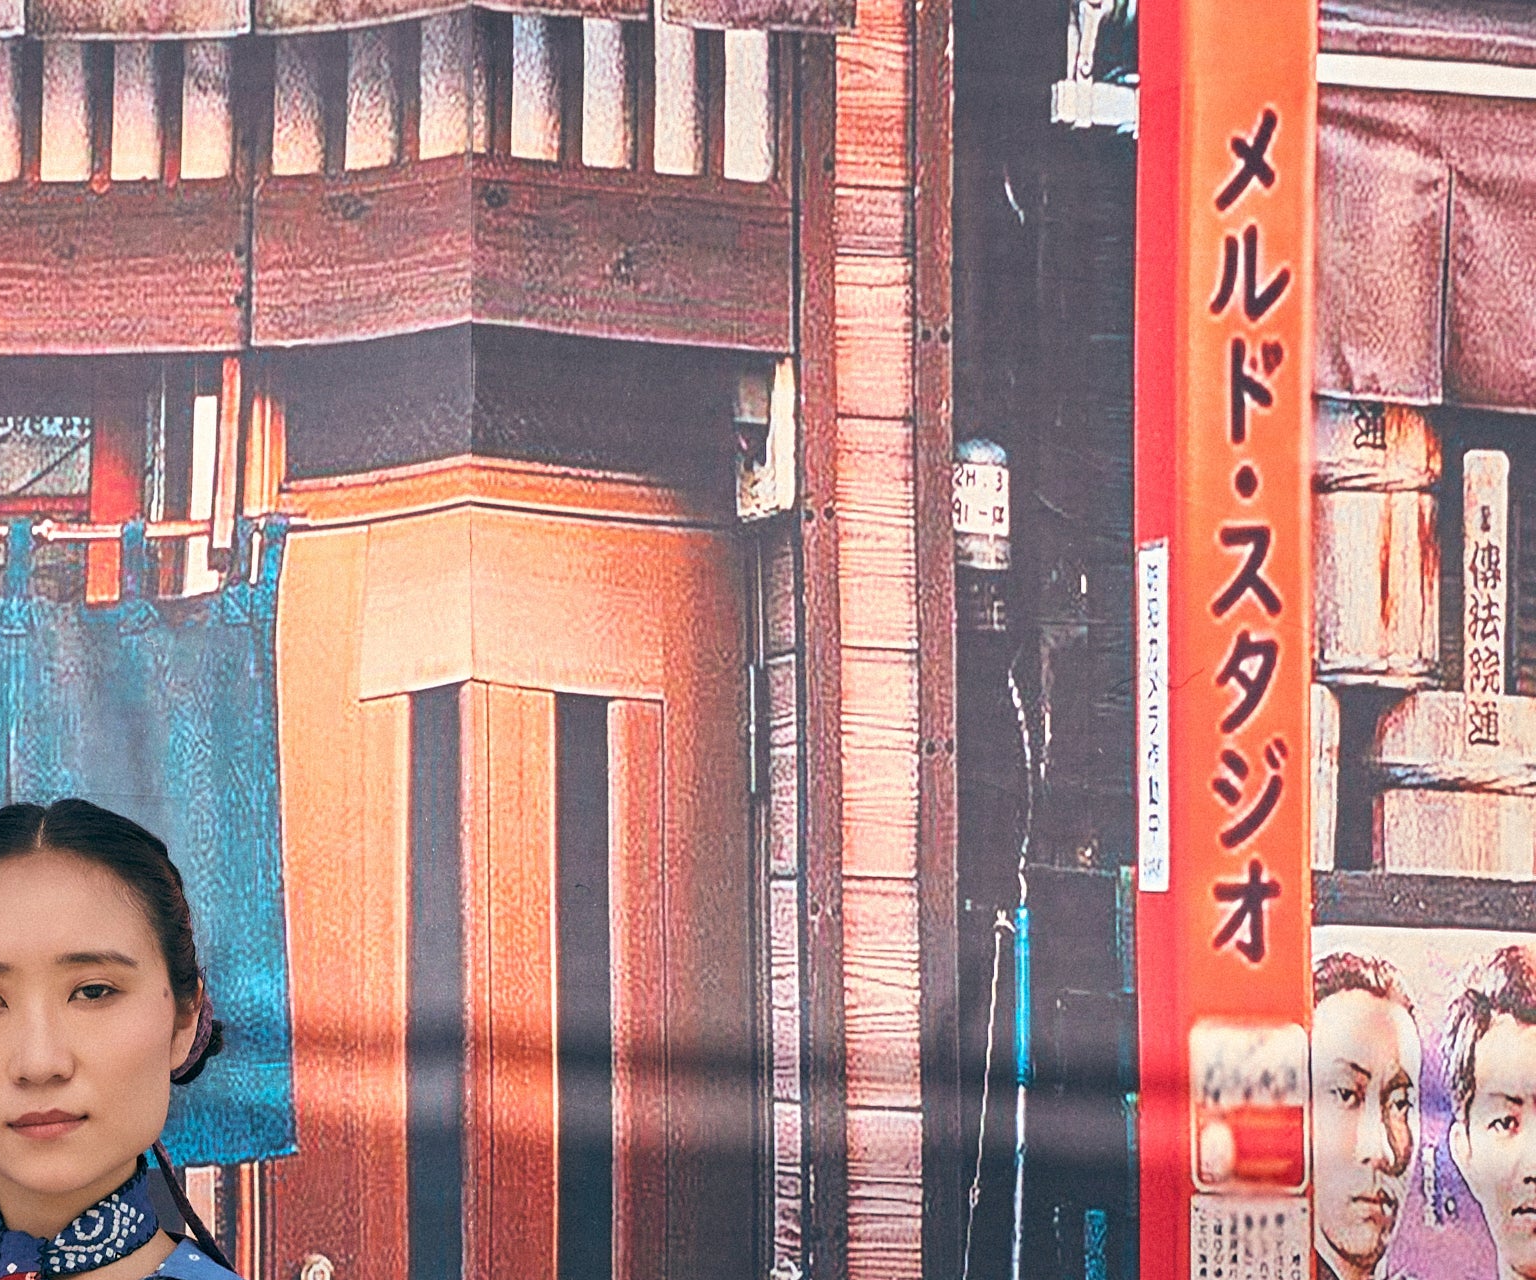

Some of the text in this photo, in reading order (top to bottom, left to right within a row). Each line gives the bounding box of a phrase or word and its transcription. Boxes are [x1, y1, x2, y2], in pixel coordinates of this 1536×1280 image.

[1210, 109, 1292, 962] メルド・スタジオ
